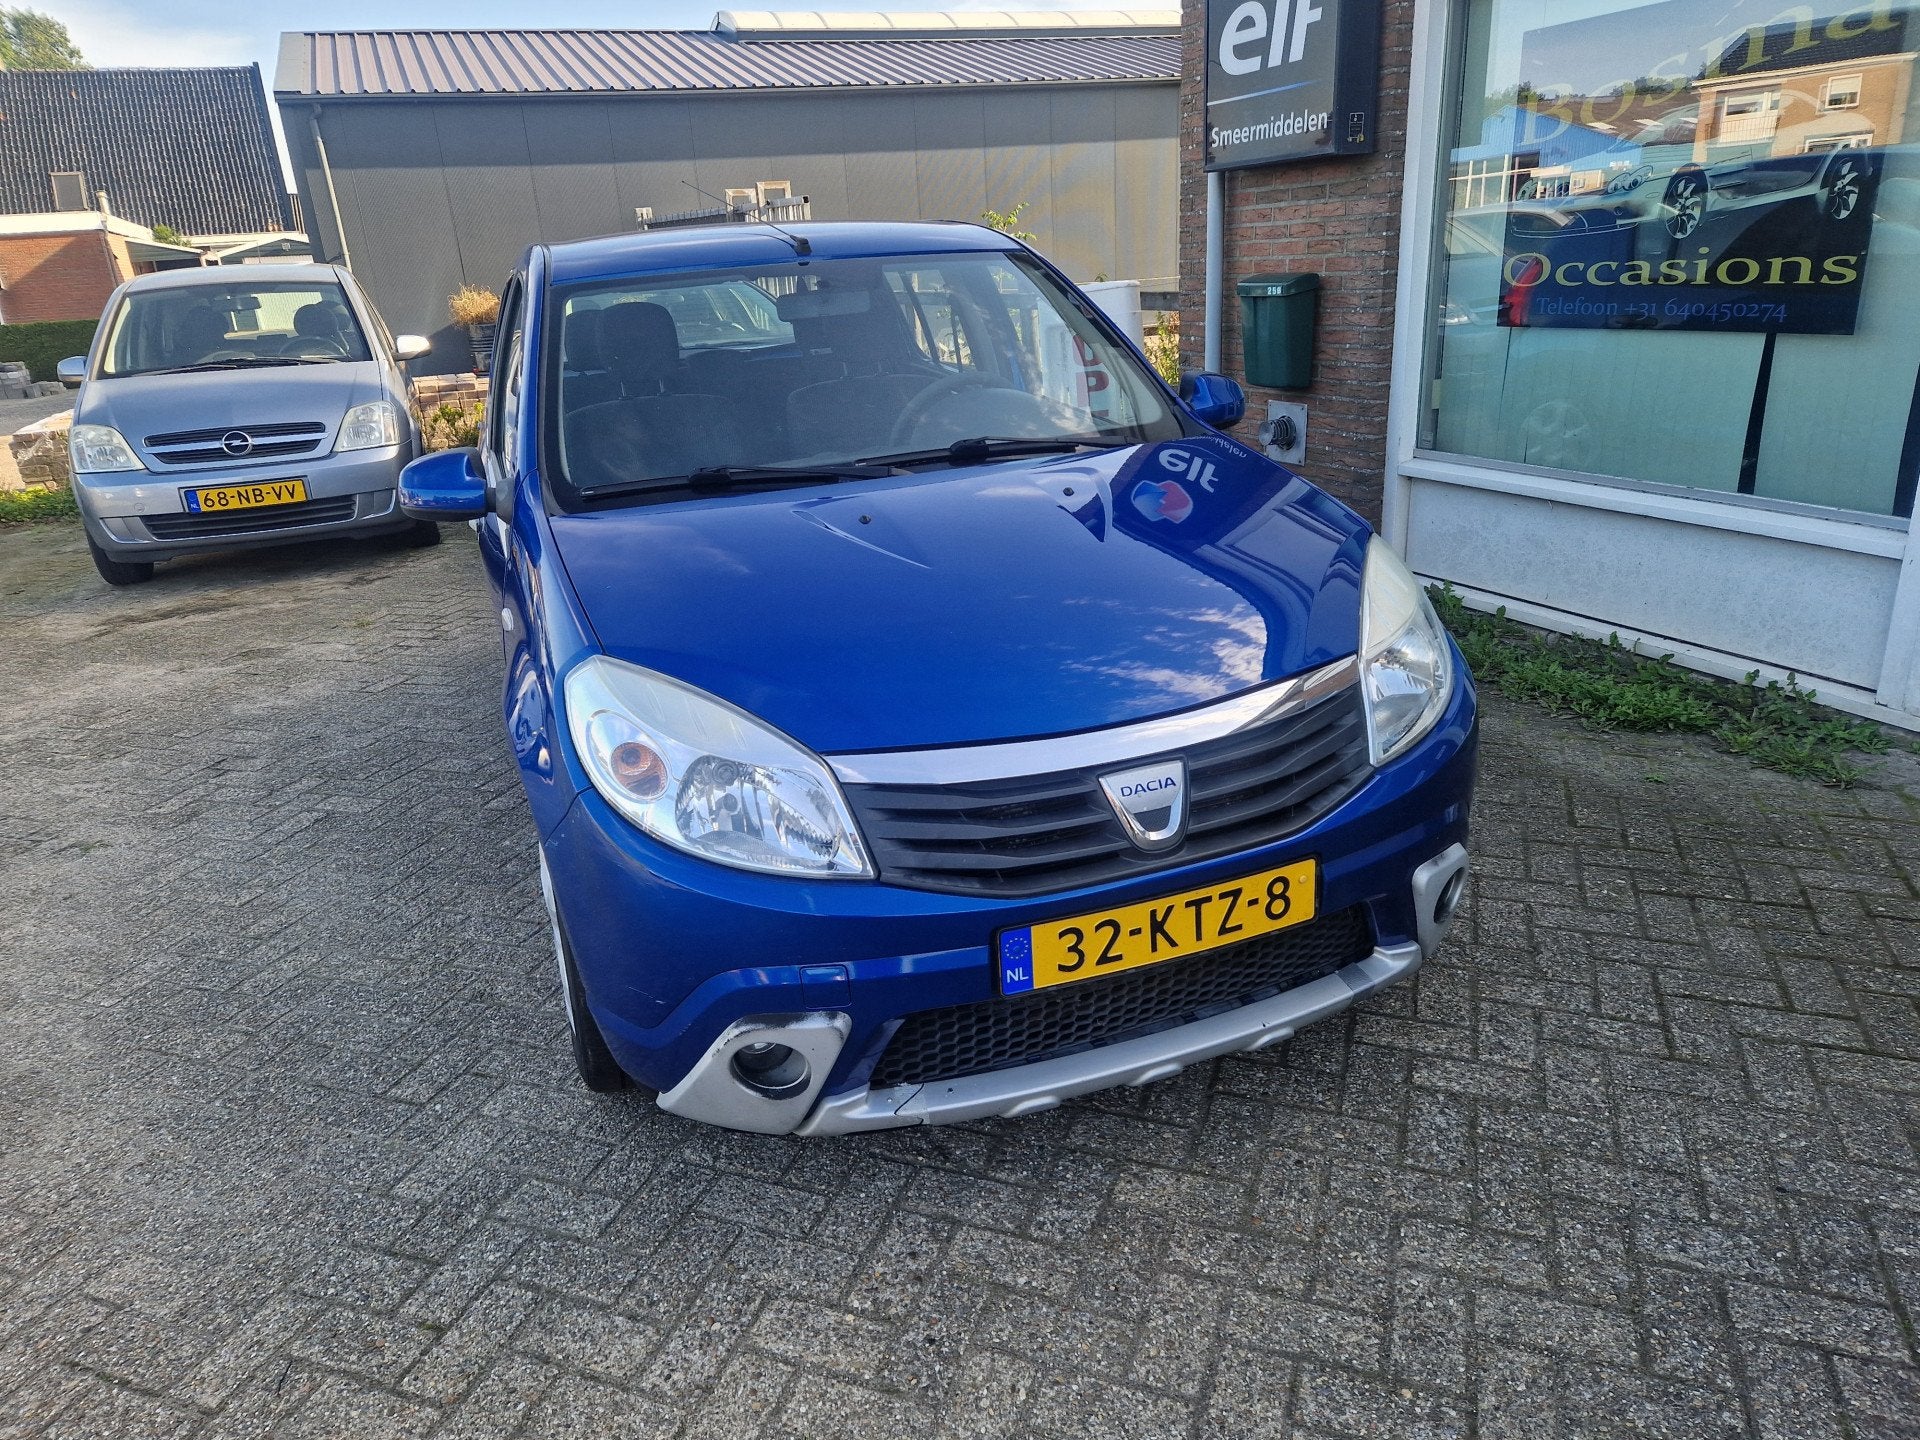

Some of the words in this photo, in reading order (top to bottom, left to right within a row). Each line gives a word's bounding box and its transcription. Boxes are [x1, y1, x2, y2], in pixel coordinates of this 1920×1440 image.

[1219, 0, 1323, 76] elf
[1519, 0, 1902, 146] Bosma
[1211, 109, 1328, 148] Smeermiddelen
[1503, 247, 1858, 287] Occasions
[1536, 296, 1618, 316] Telefoon
[1624, 302, 1656, 321] +31
[1665, 298, 1788, 323] 640450274
[203, 483, 295, 508] 68-NB-VV
[1120, 776, 1177, 798] DACIA
[1057, 875, 1291, 973] 32-KTZ-8
[1006, 967, 1029, 983] NL
